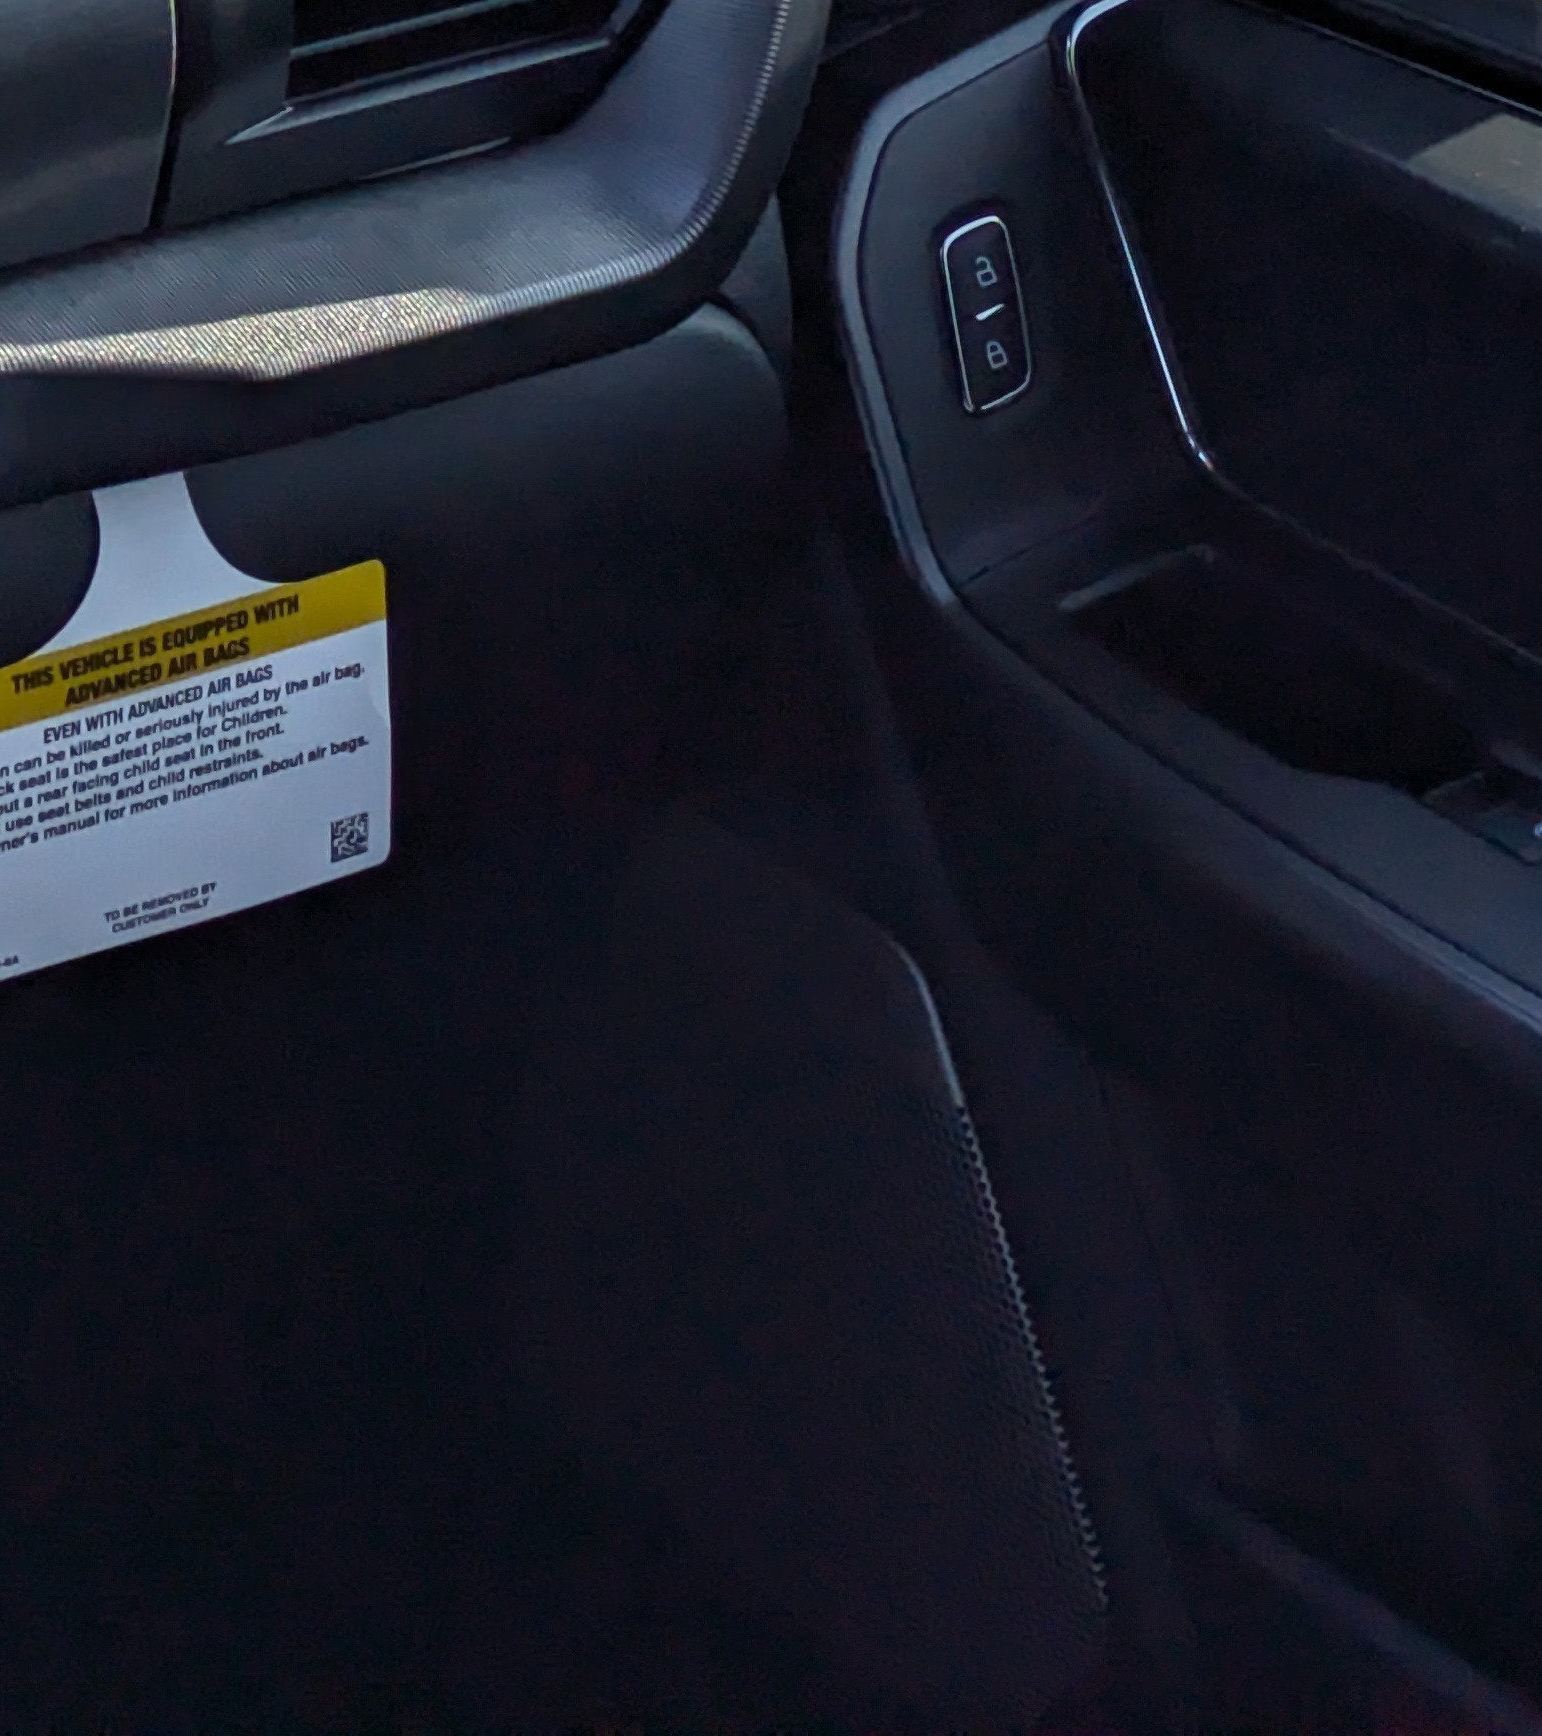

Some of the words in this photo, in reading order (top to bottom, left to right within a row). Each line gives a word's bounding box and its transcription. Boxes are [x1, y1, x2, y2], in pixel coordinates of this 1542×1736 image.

[11, 666, 54, 693] THIS
[59, 643, 134, 679] VEHICLE
[139, 637, 157, 657] IS
[162, 611, 249, 650] EQUIPPED
[253, 595, 299, 623] WITH
[65, 663, 162, 706] ADVANCED
[167, 652, 197, 677] AIR
[203, 637, 250, 667] BAGS
[14, 757, 42, 774] can
[46, 750, 66, 764] be
[70, 735, 111, 757] killed
[115, 731, 131, 745] or
[135, 710, 204, 739] seriously
[208, 691, 259, 717] injured
[263, 687, 281, 702] by
[285, 679, 308, 695] the
[312, 671, 331, 687] air
[334, 663, 365, 680] bag.
[44, 720, 81, 744] EVEN
[85, 708, 123, 731] WITH
[128, 686, 203, 720] ADVANCED
[207, 677, 231, 697] AIR
[236, 665, 273, 688] BAGS
[5, 815, 33, 832] use
[38, 803, 70, 823] seat
[74, 793, 111, 812] belts
[116, 780, 144, 800] and
[148, 769, 185, 790] child
[189, 749, 263, 778] restraints.
[19, 771, 51, 791] seat
[56, 767, 69, 780] is
[74, 760, 98, 775] the
[102, 744, 147, 767] safest
[152, 732, 192, 755] place
[196, 724, 218, 739] for
[221, 706, 288, 732] Children.
[24, 796, 33, 808] a
[37, 786, 68, 804] rear
[72, 772, 119, 794] facing
[123, 757, 160, 779] child
[165, 748, 195, 767] seat
[200, 744, 214, 757] in
[218, 736, 241, 752] the
[245, 723, 284, 744] front.
[44, 812, 100, 839] manual
[104, 806, 126, 822] for
[130, 795, 168, 815] more
[173, 769, 258, 801] information
[262, 753, 304, 776] about
[308, 747, 327, 762] air
[330, 736, 369, 755] bags.
[104, 910, 120, 922] TO
[123, 904, 138, 917] BE
[142, 887, 198, 910] REMOVED
[201, 882, 217, 895] BY
[112, 907, 176, 933] CUSTOMER
[179, 897, 209, 913] ONLY
